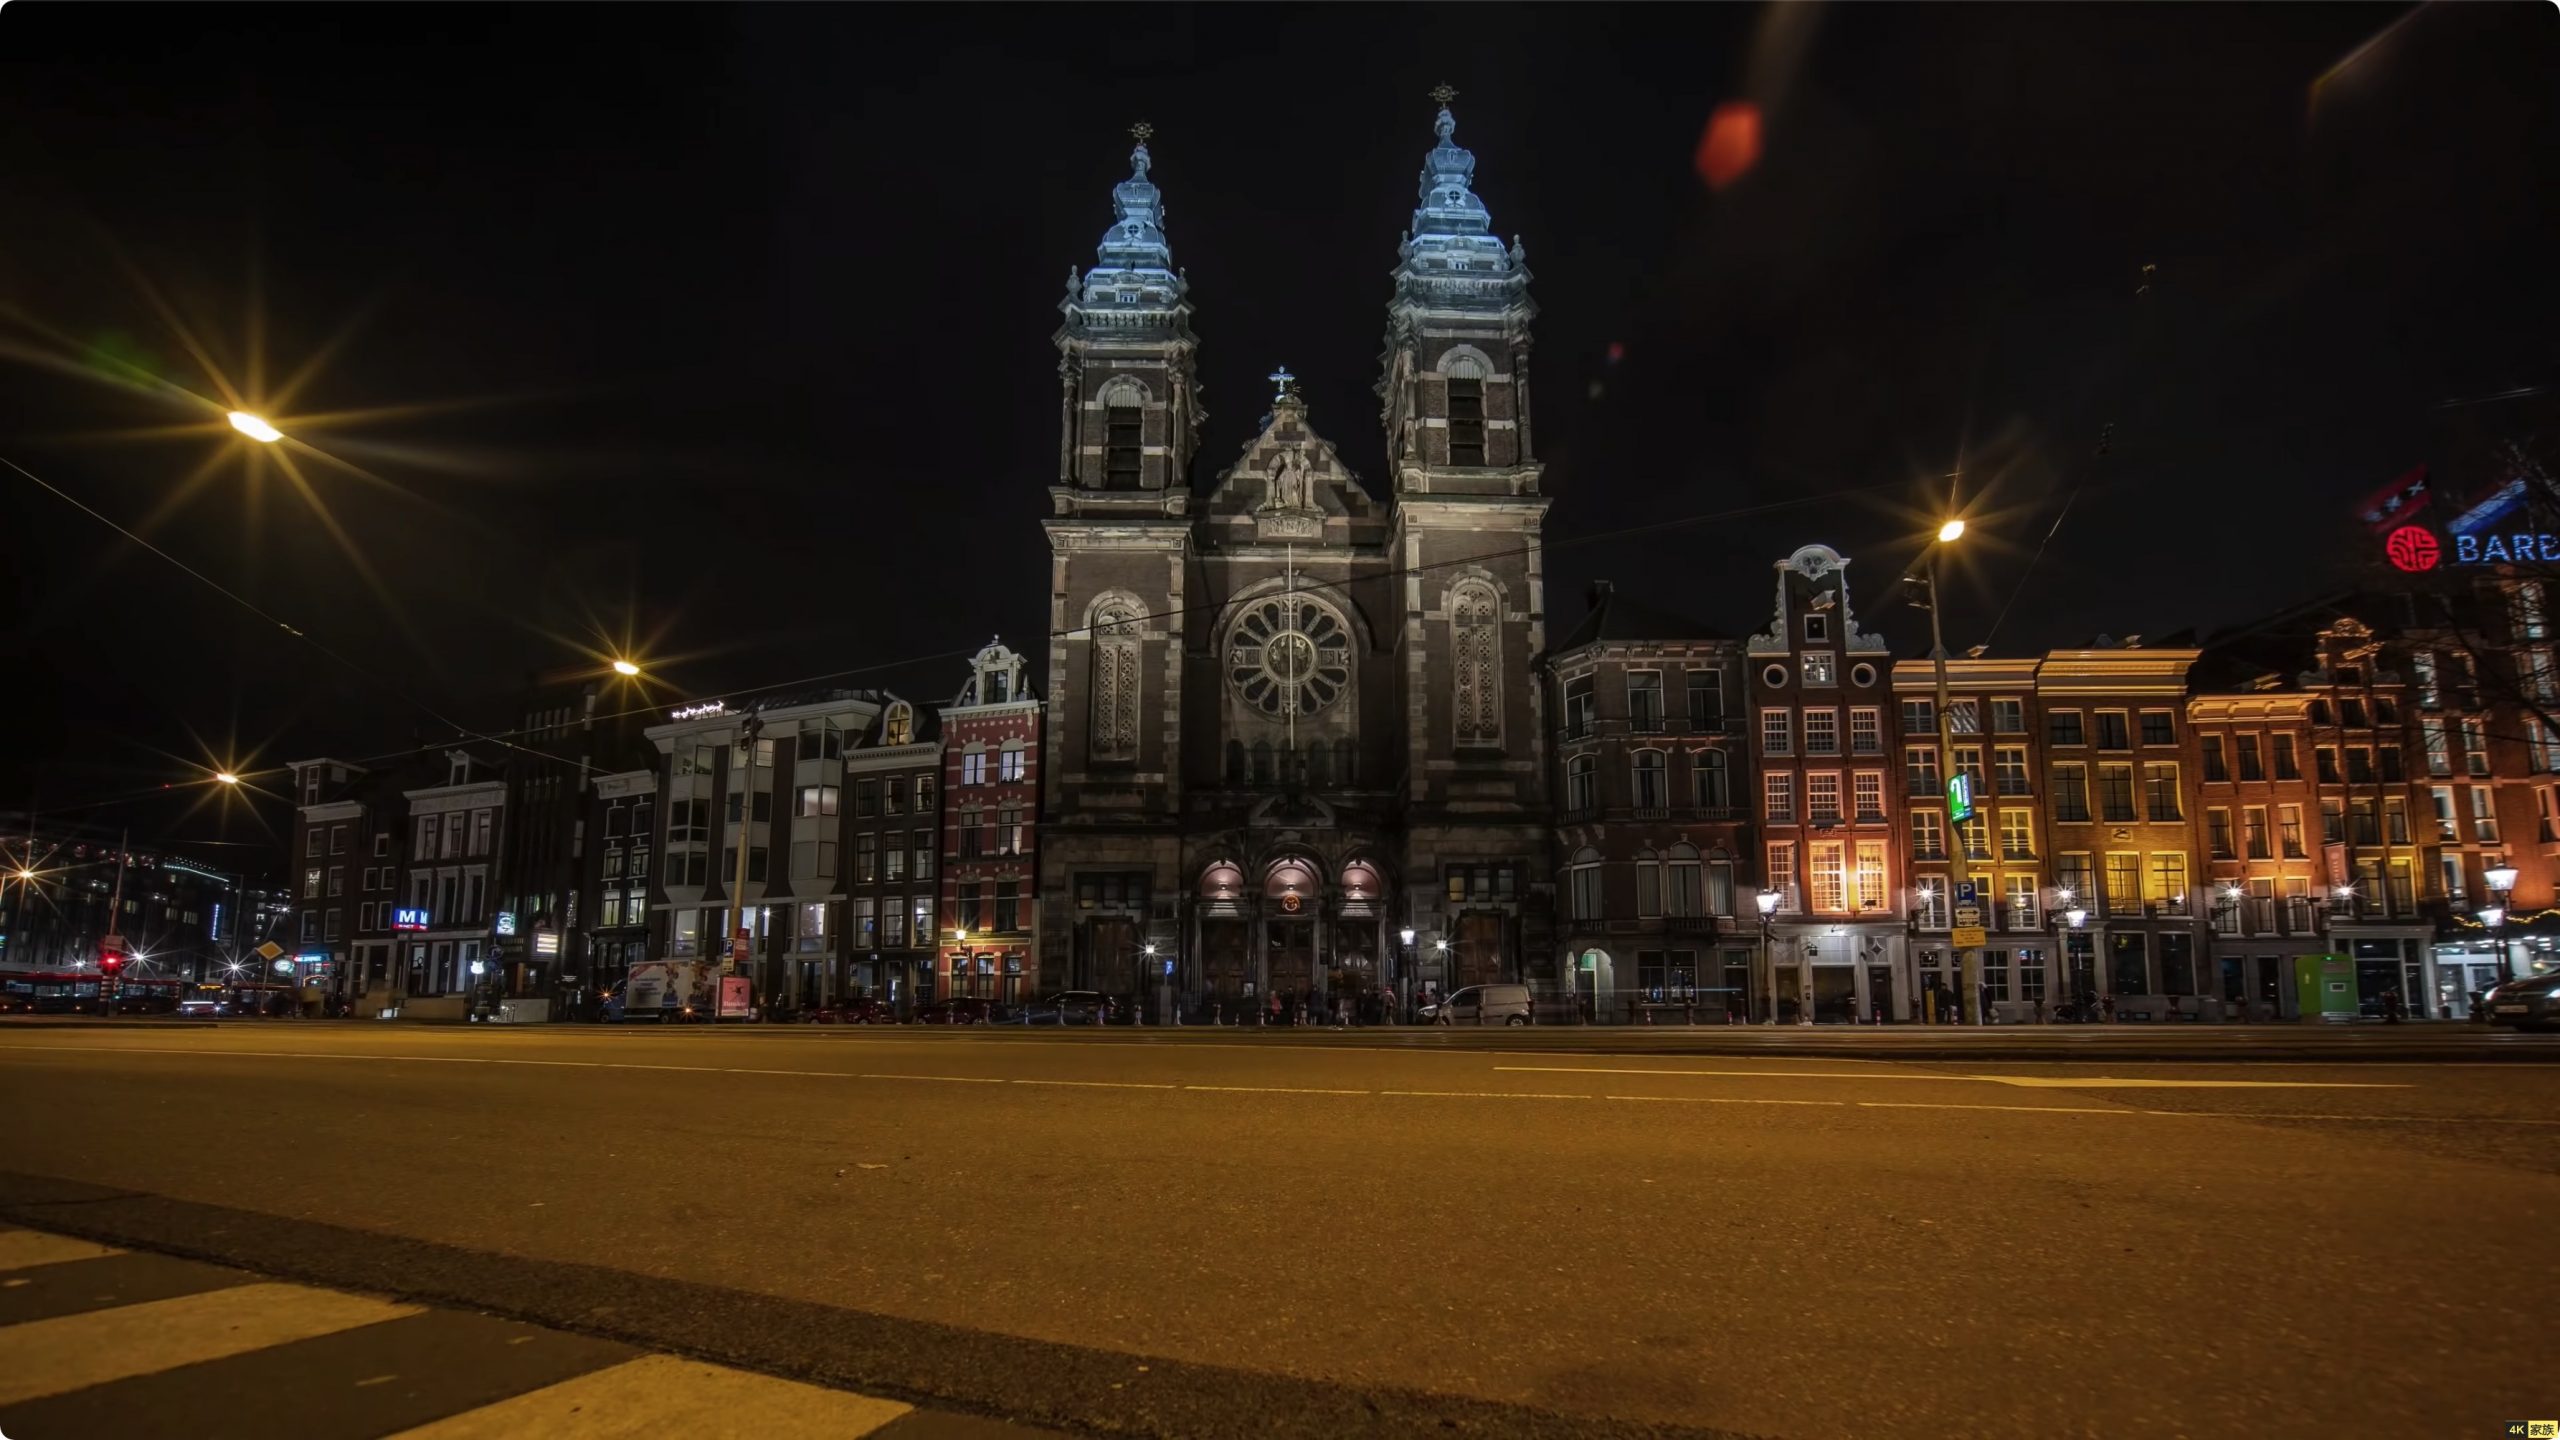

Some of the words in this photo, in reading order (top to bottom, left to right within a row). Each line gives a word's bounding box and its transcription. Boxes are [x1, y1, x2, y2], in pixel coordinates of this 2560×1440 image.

[1960, 884, 1972, 898] P
[399, 910, 416, 923] M
[726, 940, 733, 951] P
